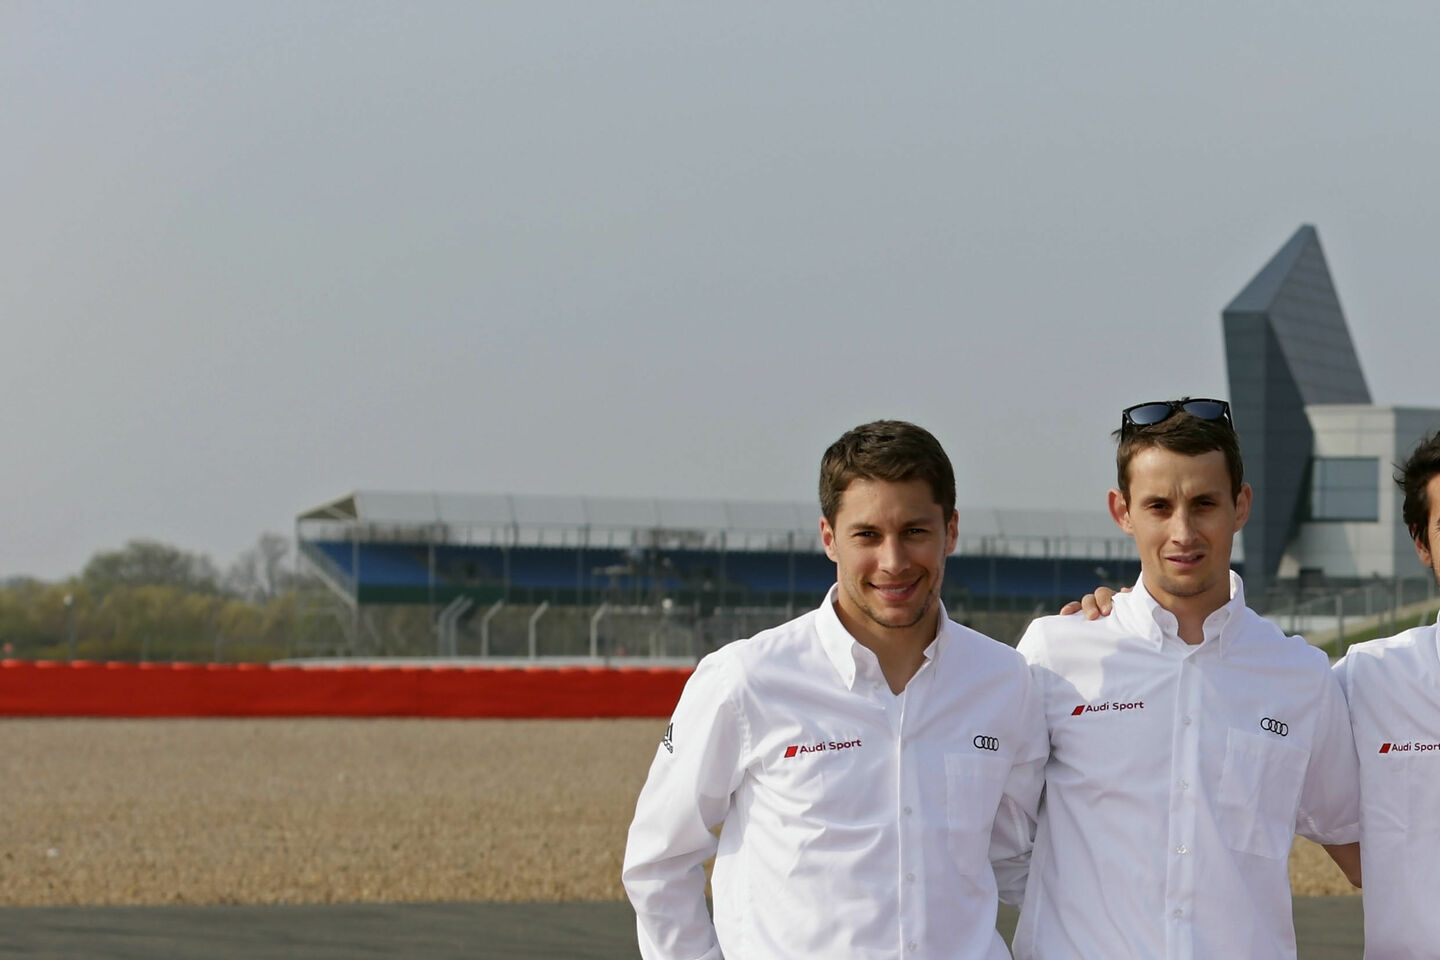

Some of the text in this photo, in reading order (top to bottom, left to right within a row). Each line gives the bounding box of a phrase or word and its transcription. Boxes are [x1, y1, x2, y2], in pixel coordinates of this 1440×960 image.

[1085, 701, 1144, 713] Audi Sport
[800, 739, 863, 754] Audi Sport
[1391, 742, 1412, 752] Audi
